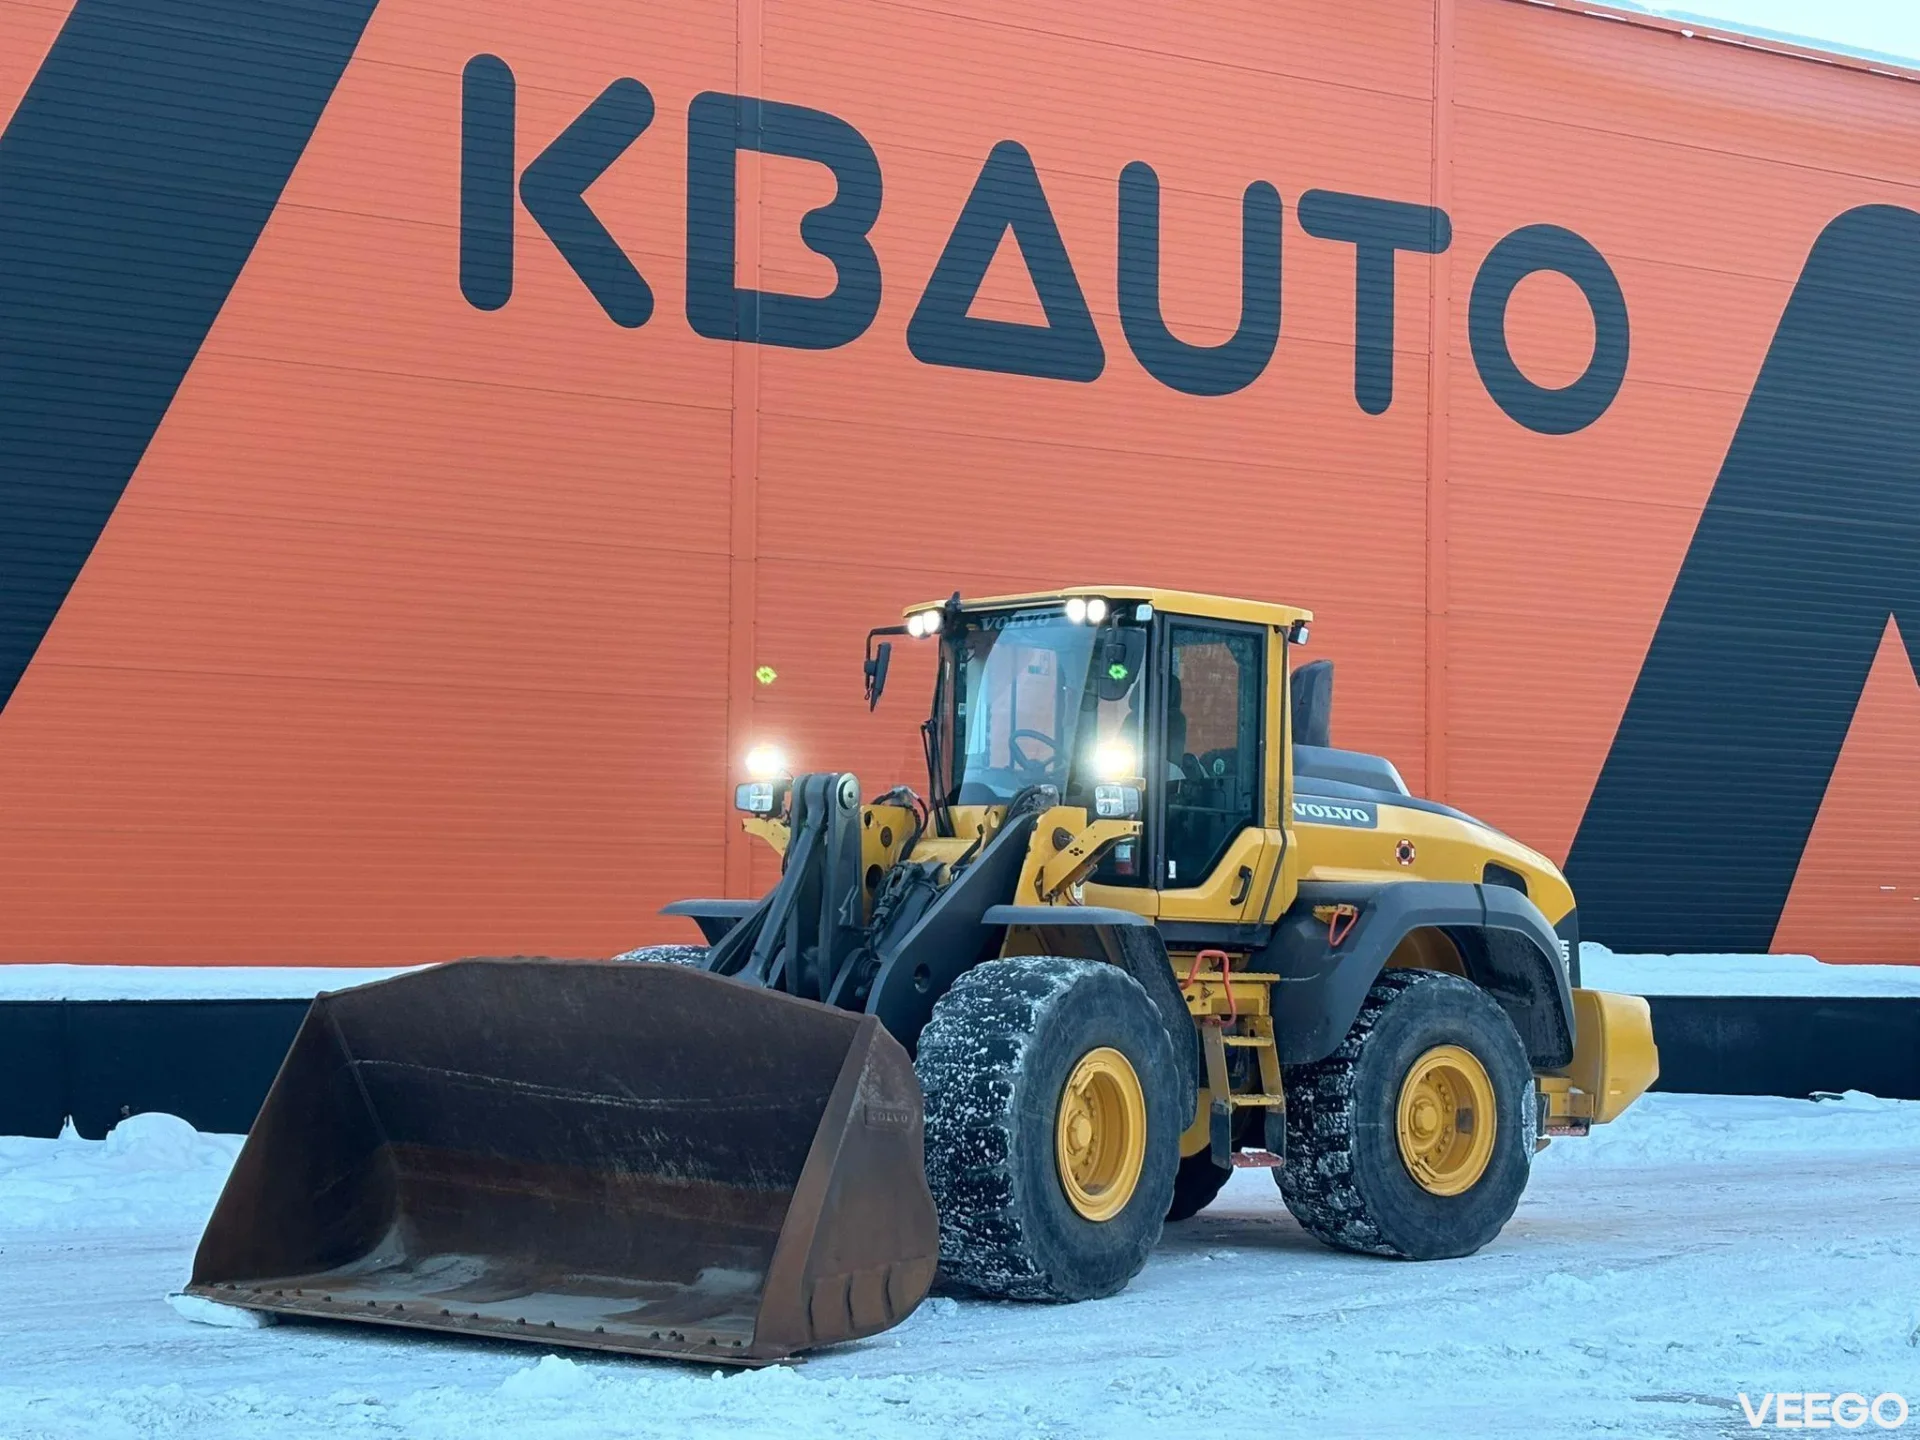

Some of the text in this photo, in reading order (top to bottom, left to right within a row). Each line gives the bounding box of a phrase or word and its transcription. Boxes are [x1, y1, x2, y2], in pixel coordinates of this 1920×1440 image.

[980, 612, 1050, 631] VOLVO
[1293, 803, 1370, 822] VOLVO
[871, 1111, 908, 1123] VOLVO
